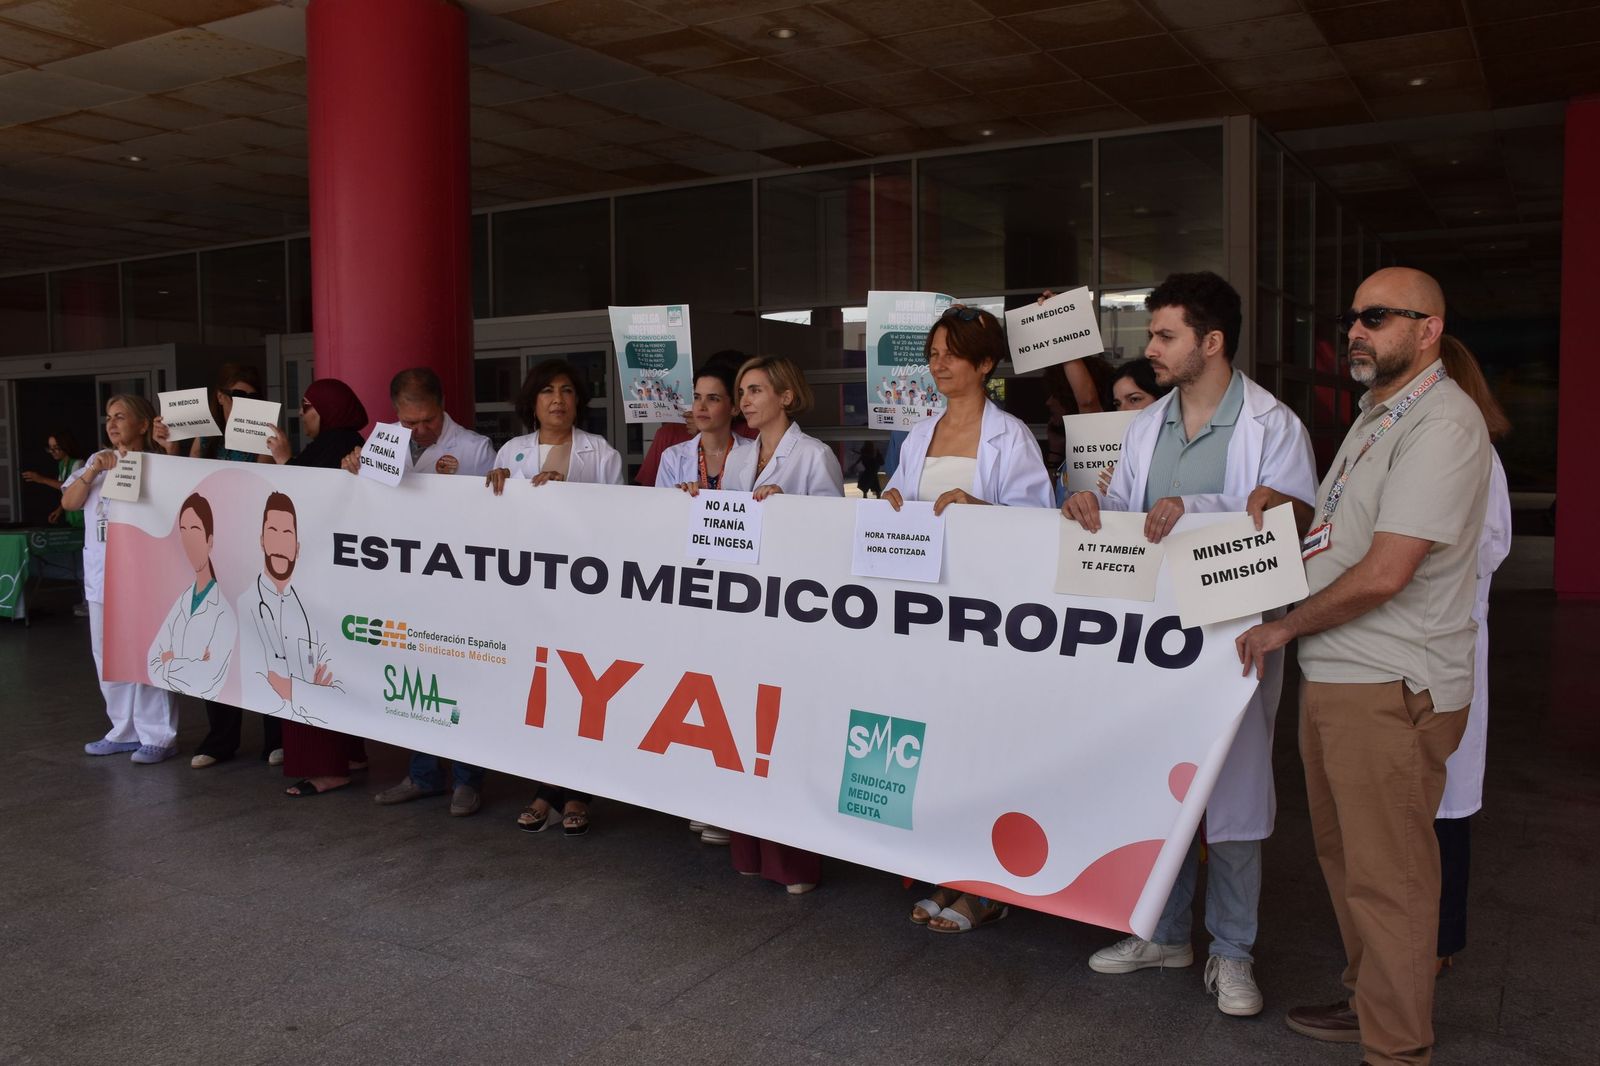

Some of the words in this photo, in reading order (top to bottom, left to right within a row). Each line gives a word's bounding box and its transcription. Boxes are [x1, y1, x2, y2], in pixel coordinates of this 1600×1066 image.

[1020, 316, 1035, 326] SIN
[1036, 303, 1076, 320] MÉDICOS
[1018, 345, 1031, 354] NO
[1032, 340, 1050, 351] HAY
[1052, 329, 1091, 345] SANIDAD
[891, 363, 930, 377] UNIDOS
[168, 400, 177, 408] SIN
[168, 421, 176, 429] NO
[187, 418, 211, 427] SANIDAD
[245, 428, 267, 437] COTIZADA
[376, 431, 385, 440] NO
[384, 433, 390, 442] A
[390, 435, 400, 445] LA
[369, 443, 396, 460] TIRANÍA
[1072, 445, 1085, 453] NO
[360, 455, 375, 468] DEL
[375, 461, 400, 477] INGESA
[1073, 461, 1084, 469] ES
[705, 500, 721, 511] NO
[722, 501, 731, 512] A
[732, 502, 746, 513] LA
[703, 517, 745, 531] TIRANÍA
[692, 534, 712, 546] DEL
[713, 535, 754, 551] INGESA
[864, 531, 885, 540] HORA
[886, 532, 931, 542] TRABAJADA
[866, 545, 887, 554] HORA
[888, 546, 927, 557] COTIZADA
[1078, 543, 1086, 552] A
[1087, 543, 1097, 553] TI
[1098, 544, 1146, 556] TAMBIÉN
[1192, 530, 1276, 561] MINISTRA
[1081, 561, 1093, 570] TE
[1096, 562, 1136, 573] AFECTA
[1200, 556, 1279, 587] DIMISIÓN
[332, 532, 610, 595] ESTATUTO
[620, 558, 878, 631] MÉDICO
[893, 589, 1205, 670] PROPIO
[341, 614, 407, 650] CESM
[407, 628, 466, 645] Confederación
[467, 637, 507, 651] Española
[407, 641, 417, 651] de
[418, 643, 466, 659] Sindicatos
[468, 650, 507, 665] Médicos
[383, 664, 448, 713] SMA
[385, 706, 410, 719] Sindicato
[410, 711, 430, 723] Médico
[524, 645, 783, 779] ¡YA!
[847, 716, 921, 774] SMC
[850, 772, 906, 795] SINDICATO
[848, 787, 888, 806] MEDICO
[846, 801, 881, 819] CEUTA
